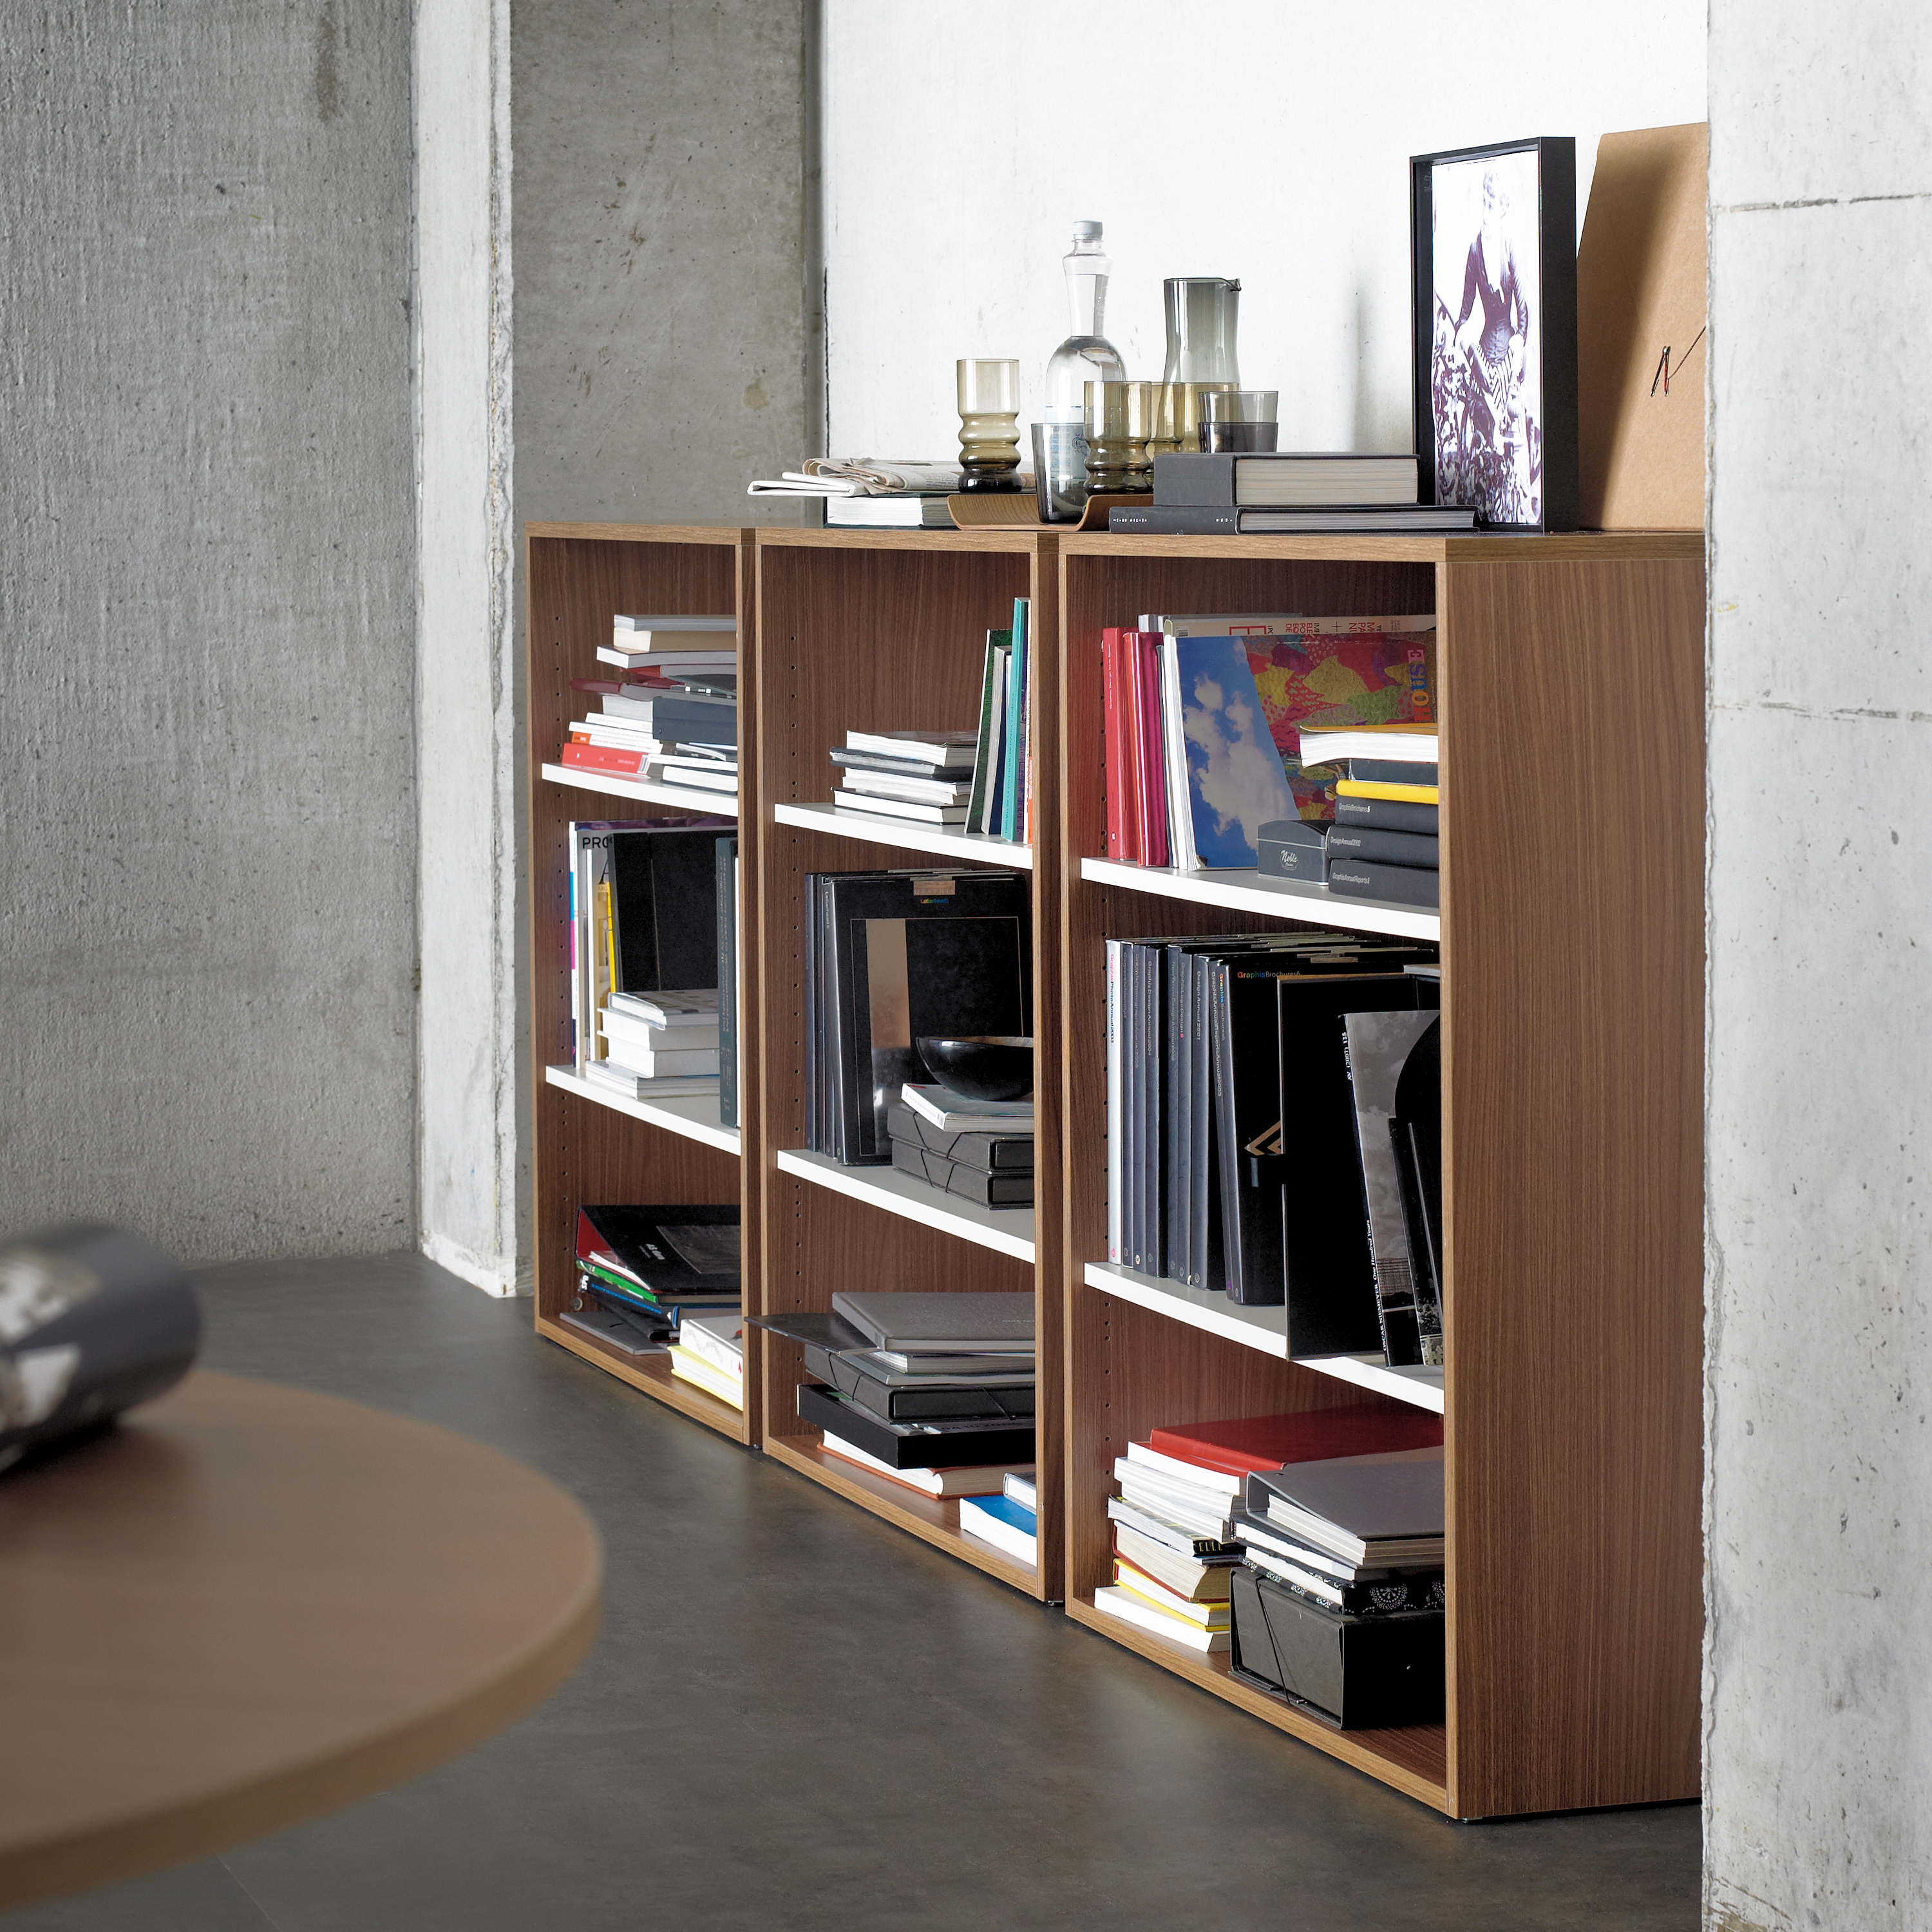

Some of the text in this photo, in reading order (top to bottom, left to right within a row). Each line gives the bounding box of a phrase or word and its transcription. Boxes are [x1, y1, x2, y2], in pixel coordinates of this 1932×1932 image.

[1280, 849, 1298, 863] Noble
[1374, 1283, 1383, 1324] NIEMEYER
[1198, 1541, 1223, 1552] ELLE
